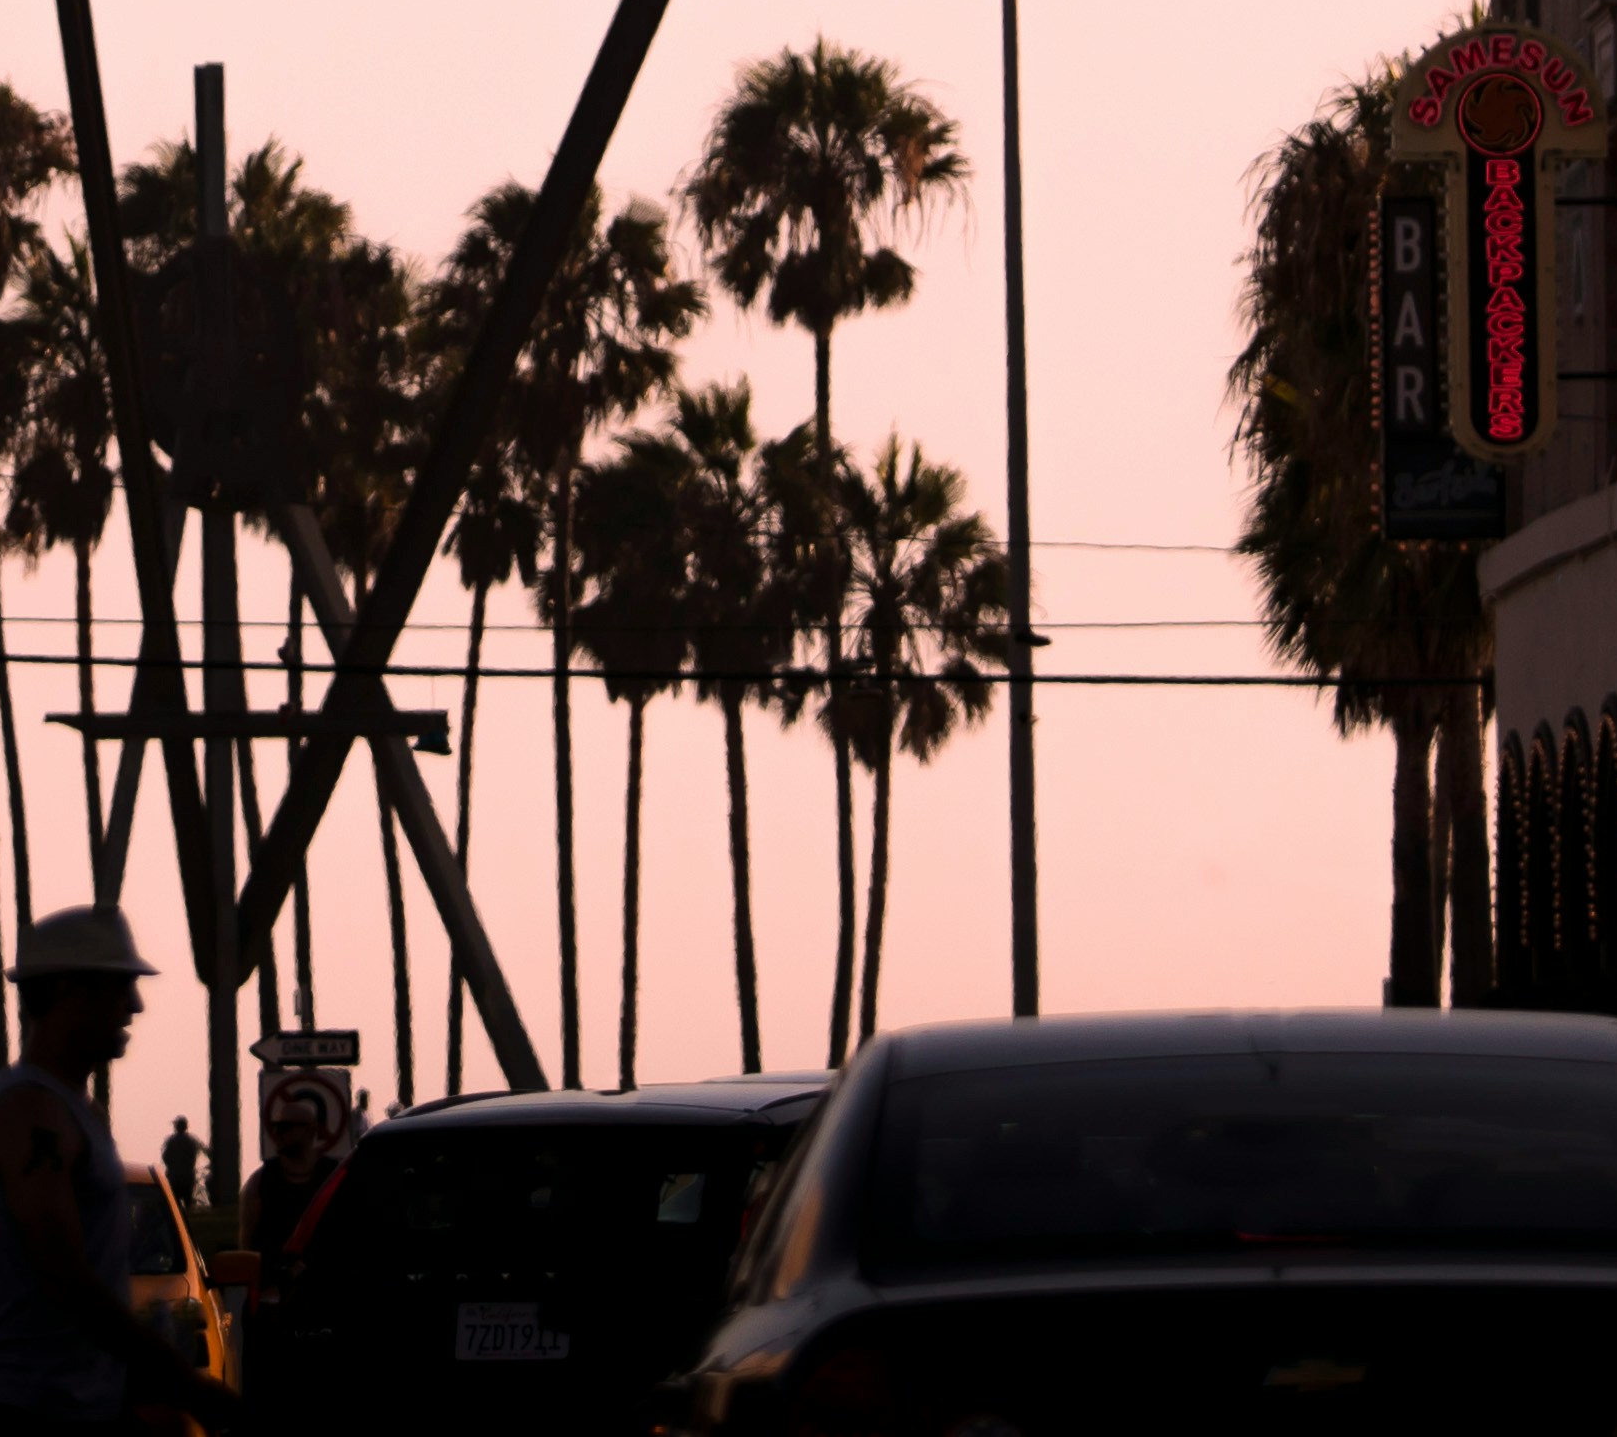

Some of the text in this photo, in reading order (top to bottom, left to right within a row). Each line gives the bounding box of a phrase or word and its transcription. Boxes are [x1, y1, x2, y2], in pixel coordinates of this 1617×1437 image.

[1409, 34, 1594, 126] SAMESUN
[1393, 216, 1425, 422] BAR
[1484, 159, 1526, 442] BACKPACKERS
